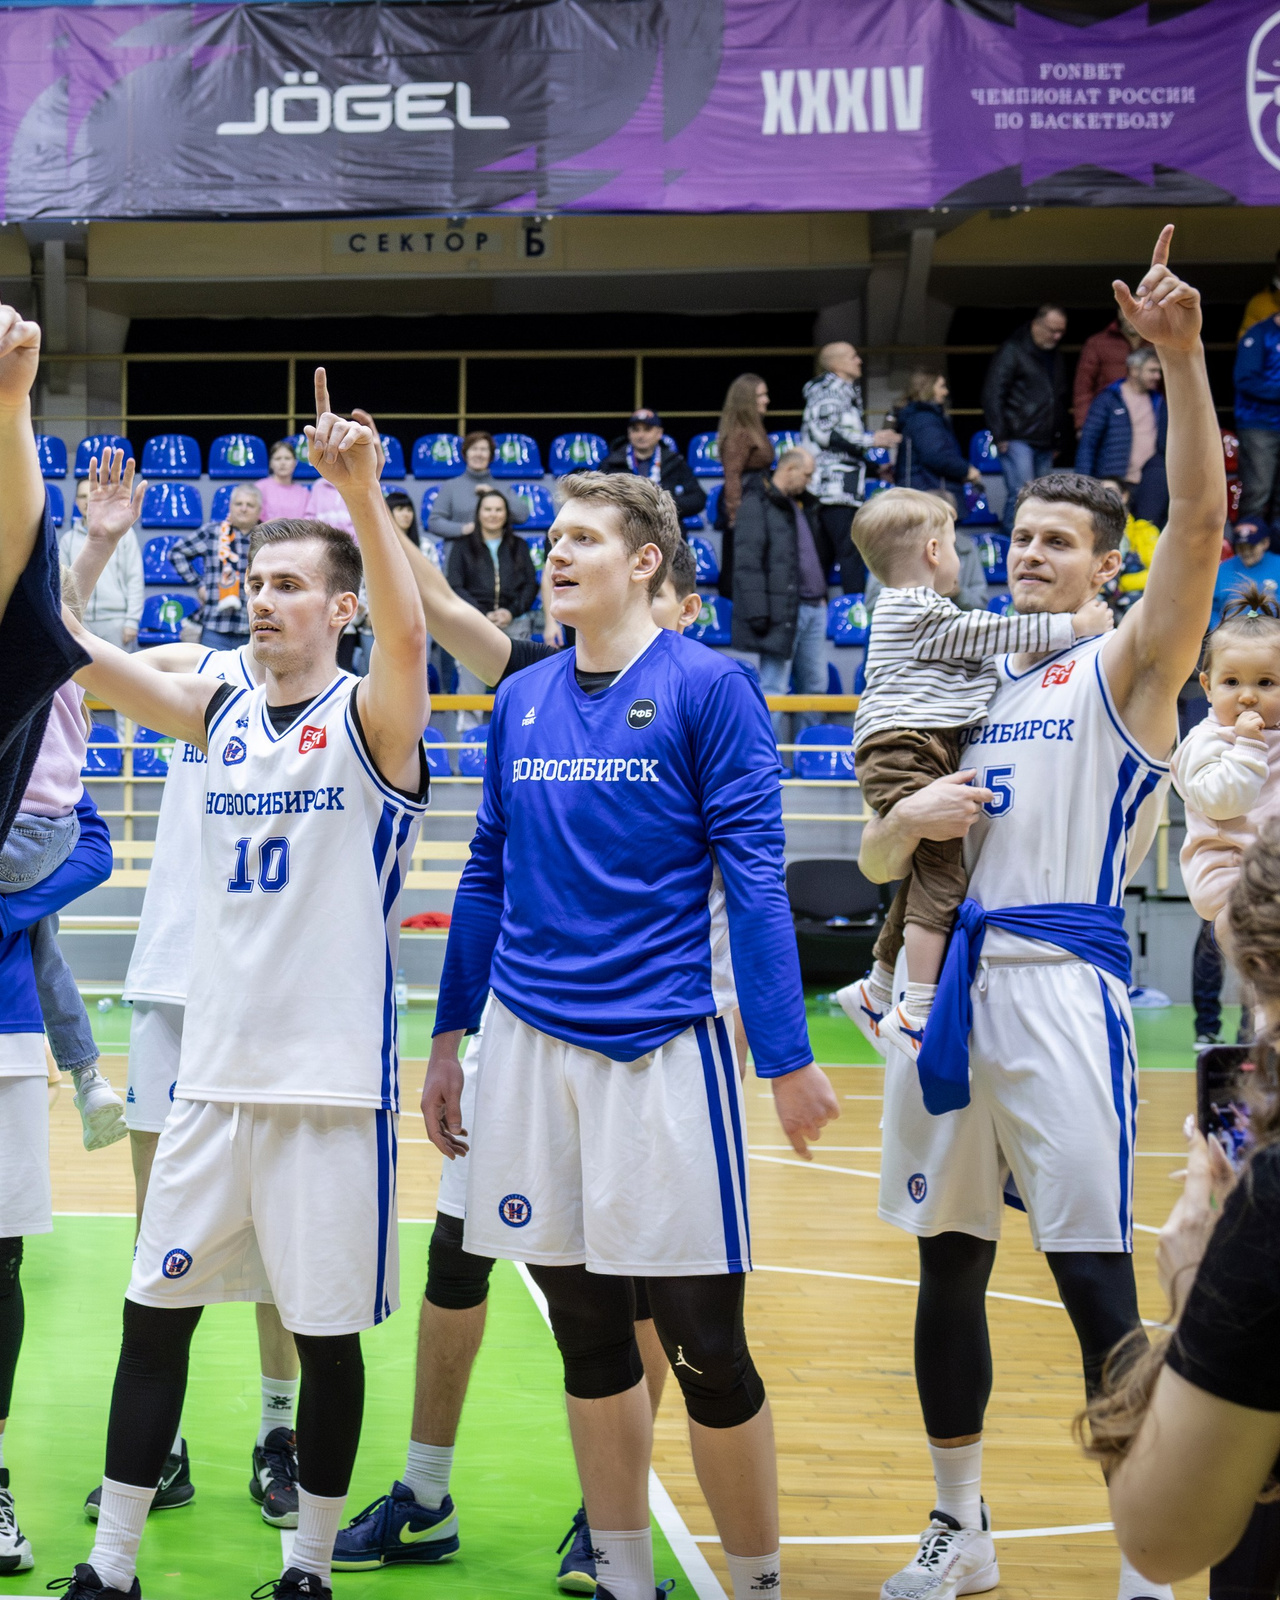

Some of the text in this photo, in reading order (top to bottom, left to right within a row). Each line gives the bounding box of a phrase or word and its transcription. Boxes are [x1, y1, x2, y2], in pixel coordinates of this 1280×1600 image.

[1039, 62, 1126, 80] FONBET
[216, 71, 511, 135] JÖGEL
[761, 66, 924, 135] XXXIV
[971, 86, 1196, 106] ЧЕМПИОНАТ РОССИИ
[994, 111, 1175, 130] ПО БАСКЕТБОЛУ
[349, 227, 545, 257] СЕКТОР Б
[630, 709, 653, 718] РФБ
[512, 757, 659, 783] НОВОСИБИРСК
[206, 787, 345, 816] НОВОСИБИРСК
[227, 836, 290, 893] 10
